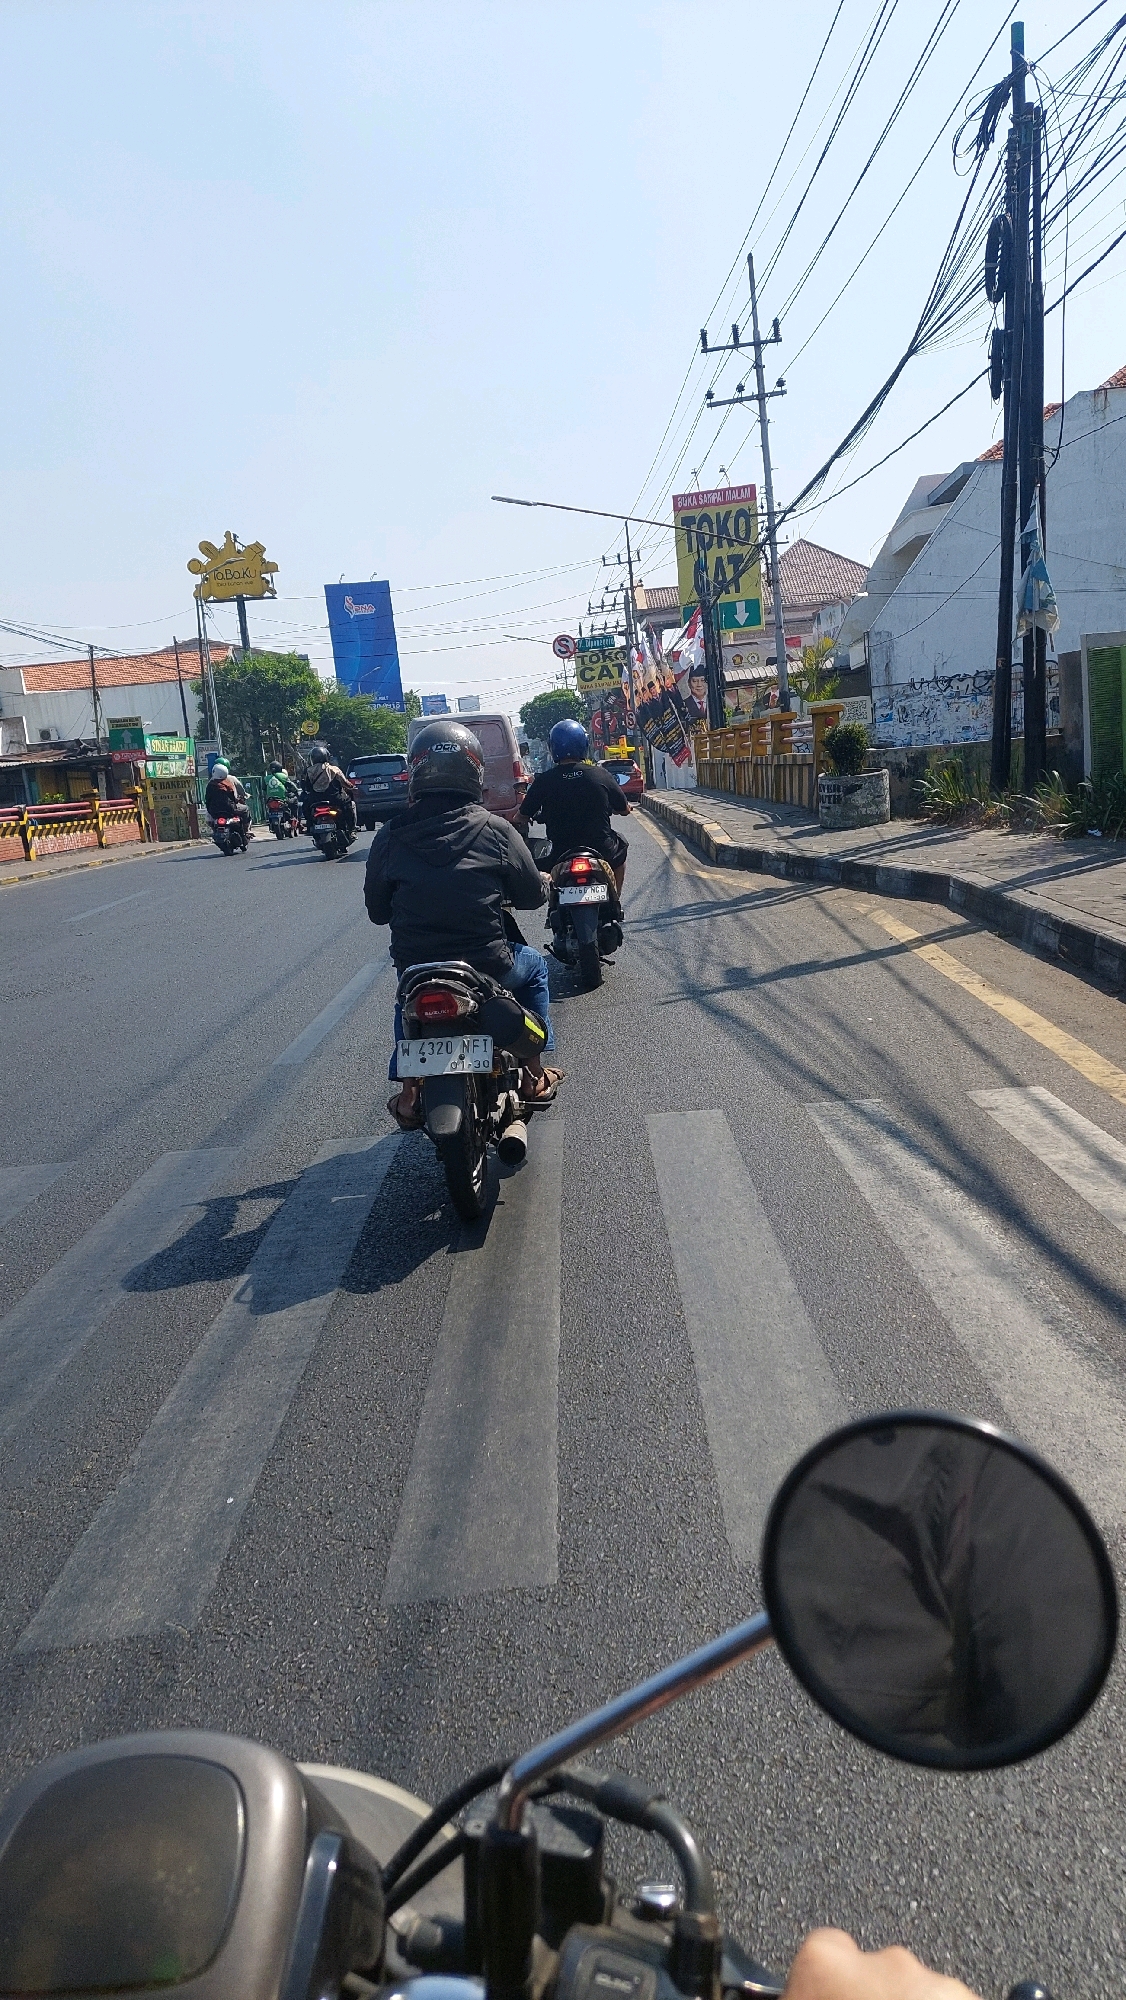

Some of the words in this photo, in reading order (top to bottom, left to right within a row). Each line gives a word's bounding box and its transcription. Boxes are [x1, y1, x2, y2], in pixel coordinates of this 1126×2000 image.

[677, 495, 698, 508] BUKA
[699, 491, 724, 505] SAMPAI
[725, 487, 751, 501] MALAM
[680, 507, 752, 553] TOKO
[693, 553, 744, 599] CAT
[577, 649, 628, 666] TOKO
[579, 662, 628, 682] CAT
[160, 779, 191, 791] BAKERY
[401, 1043, 411, 1057] W
[418, 1040, 453, 1057] 4320
[462, 1039, 489, 1054] NFI
